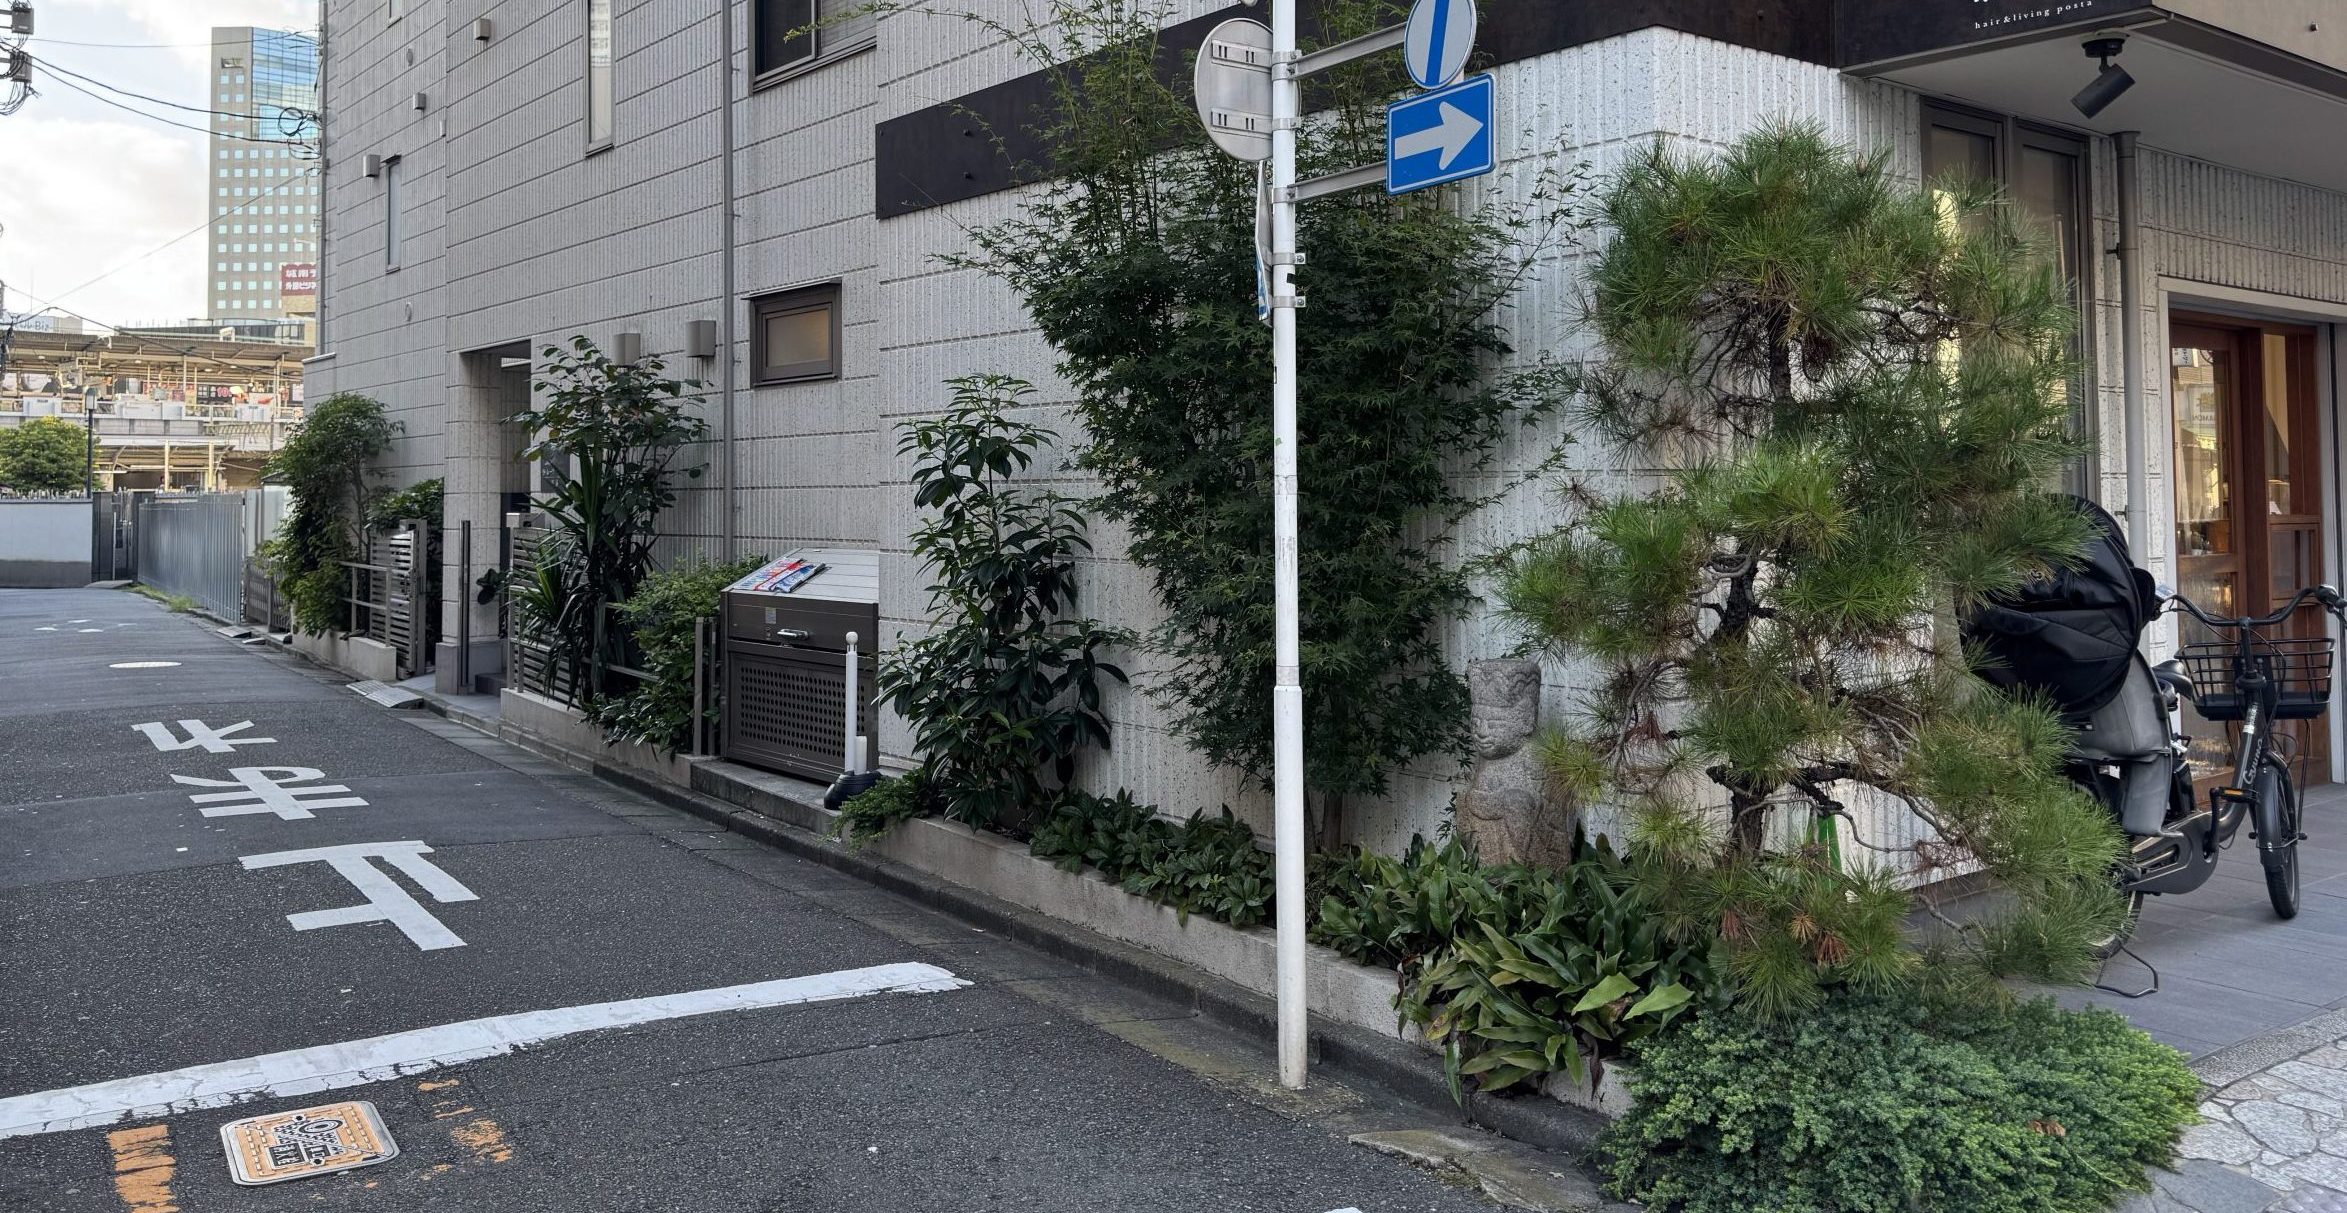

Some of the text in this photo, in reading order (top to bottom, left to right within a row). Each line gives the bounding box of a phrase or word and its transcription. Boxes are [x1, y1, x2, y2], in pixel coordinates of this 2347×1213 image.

[1975, 0, 2092, 29] hair&living posta
[130, 719, 480, 951] 止まれ
